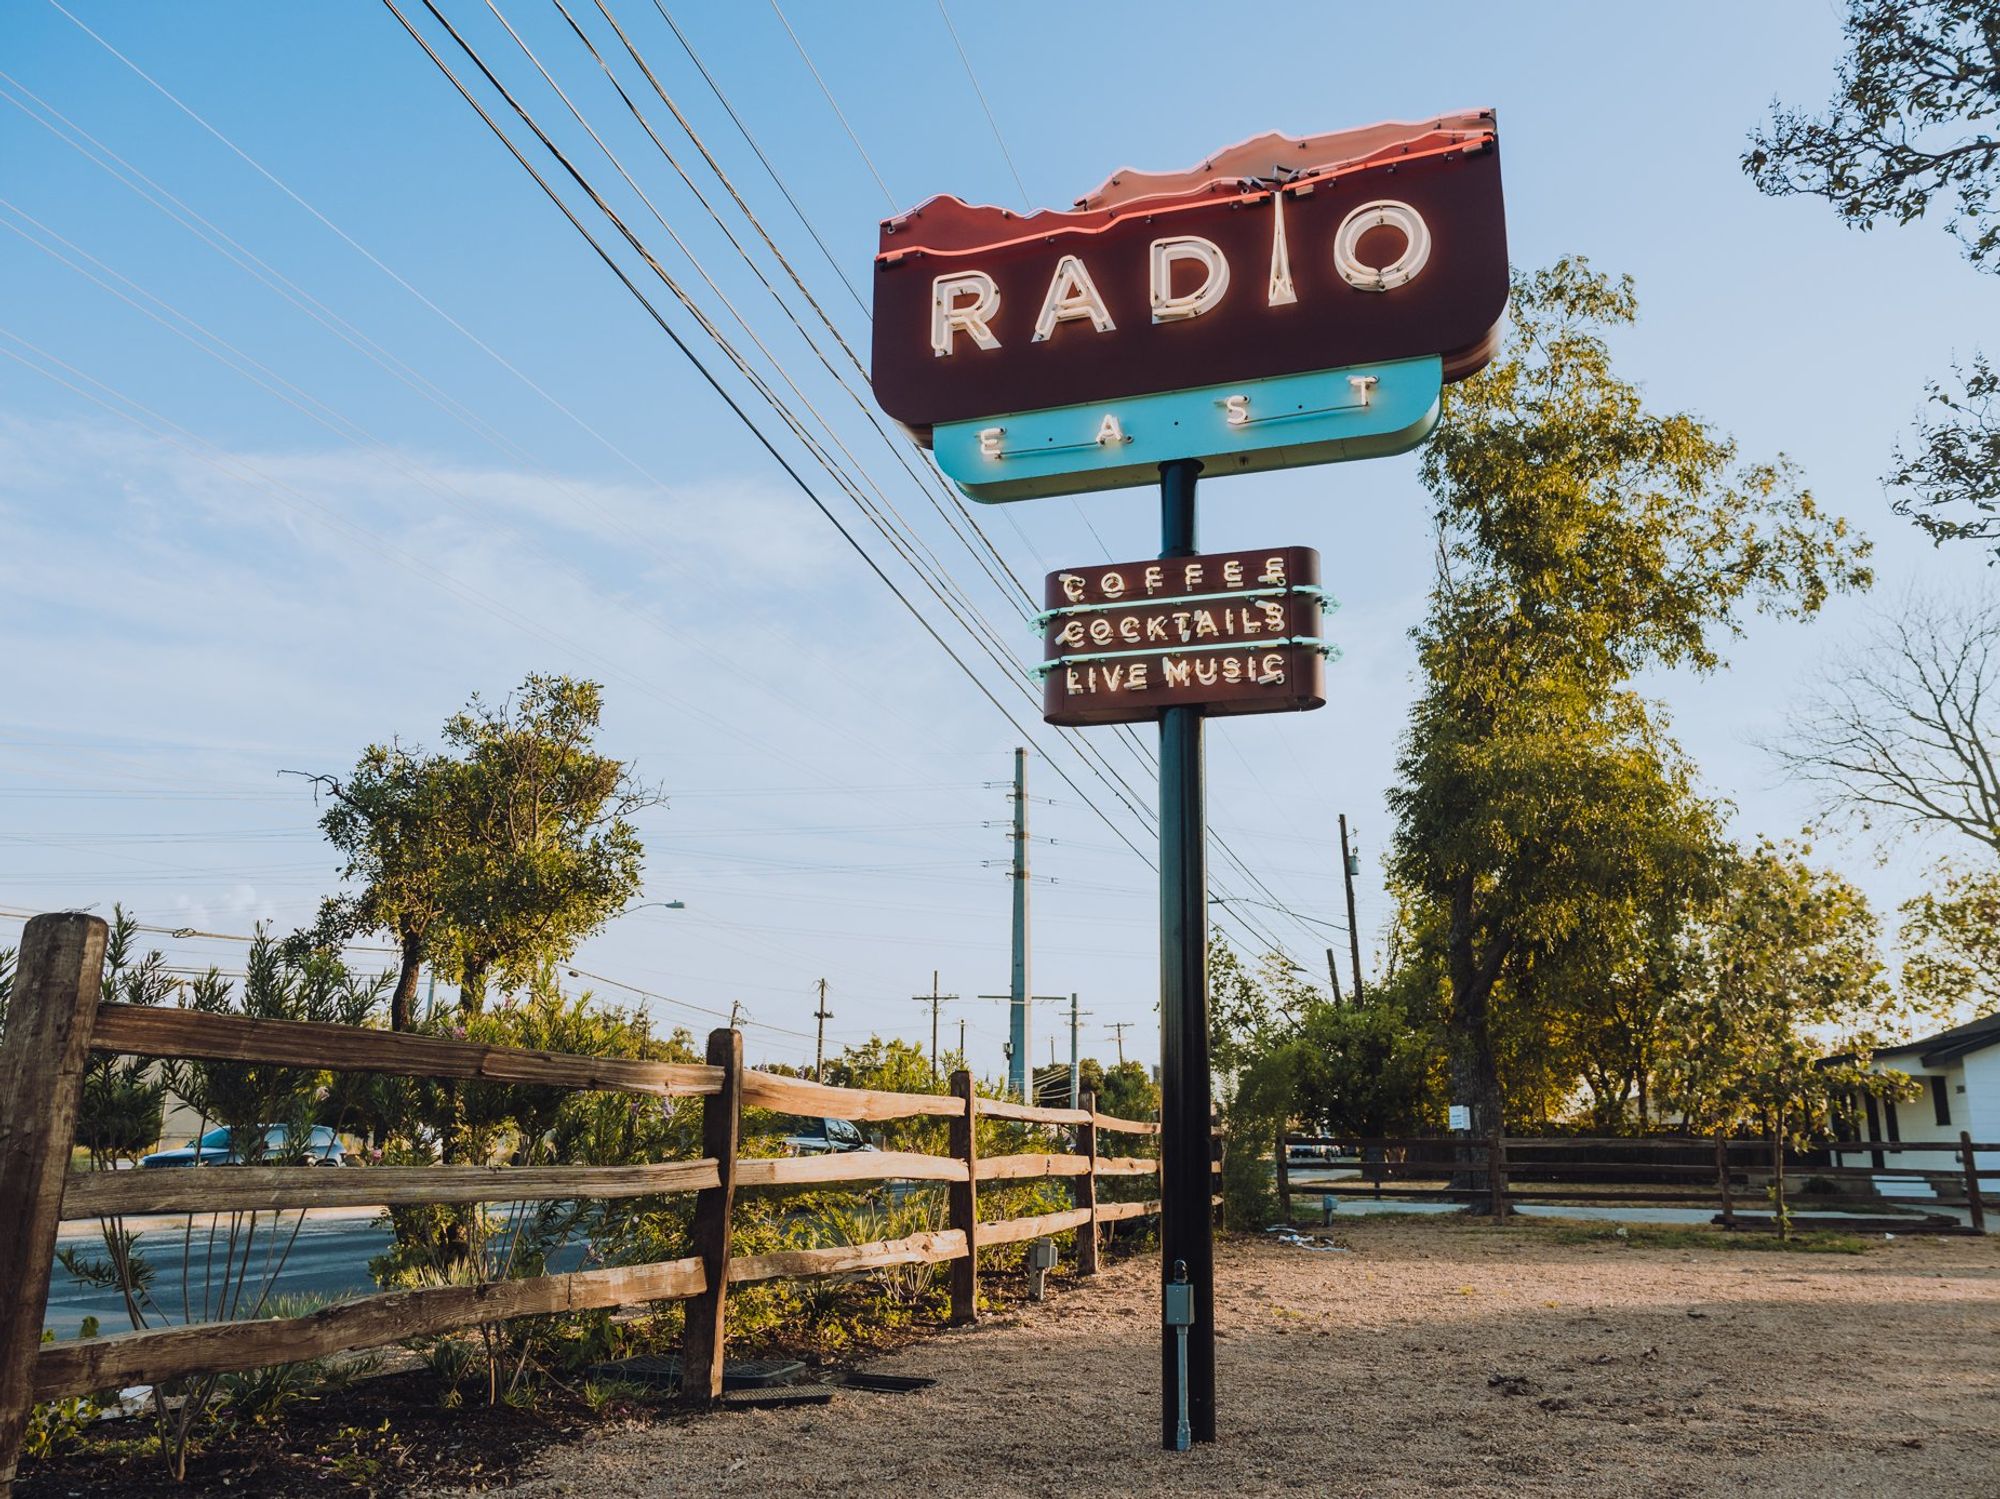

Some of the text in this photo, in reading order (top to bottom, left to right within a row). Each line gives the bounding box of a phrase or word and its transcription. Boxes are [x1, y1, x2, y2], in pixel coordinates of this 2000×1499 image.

[930, 191, 1433, 357] RADIO
[977, 375, 1379, 460] EAST
[1063, 557, 1285, 602] COFFEE
[1063, 601, 1286, 648] COCKTAILS
[1066, 653, 1285, 695] LIVE MUSIC
